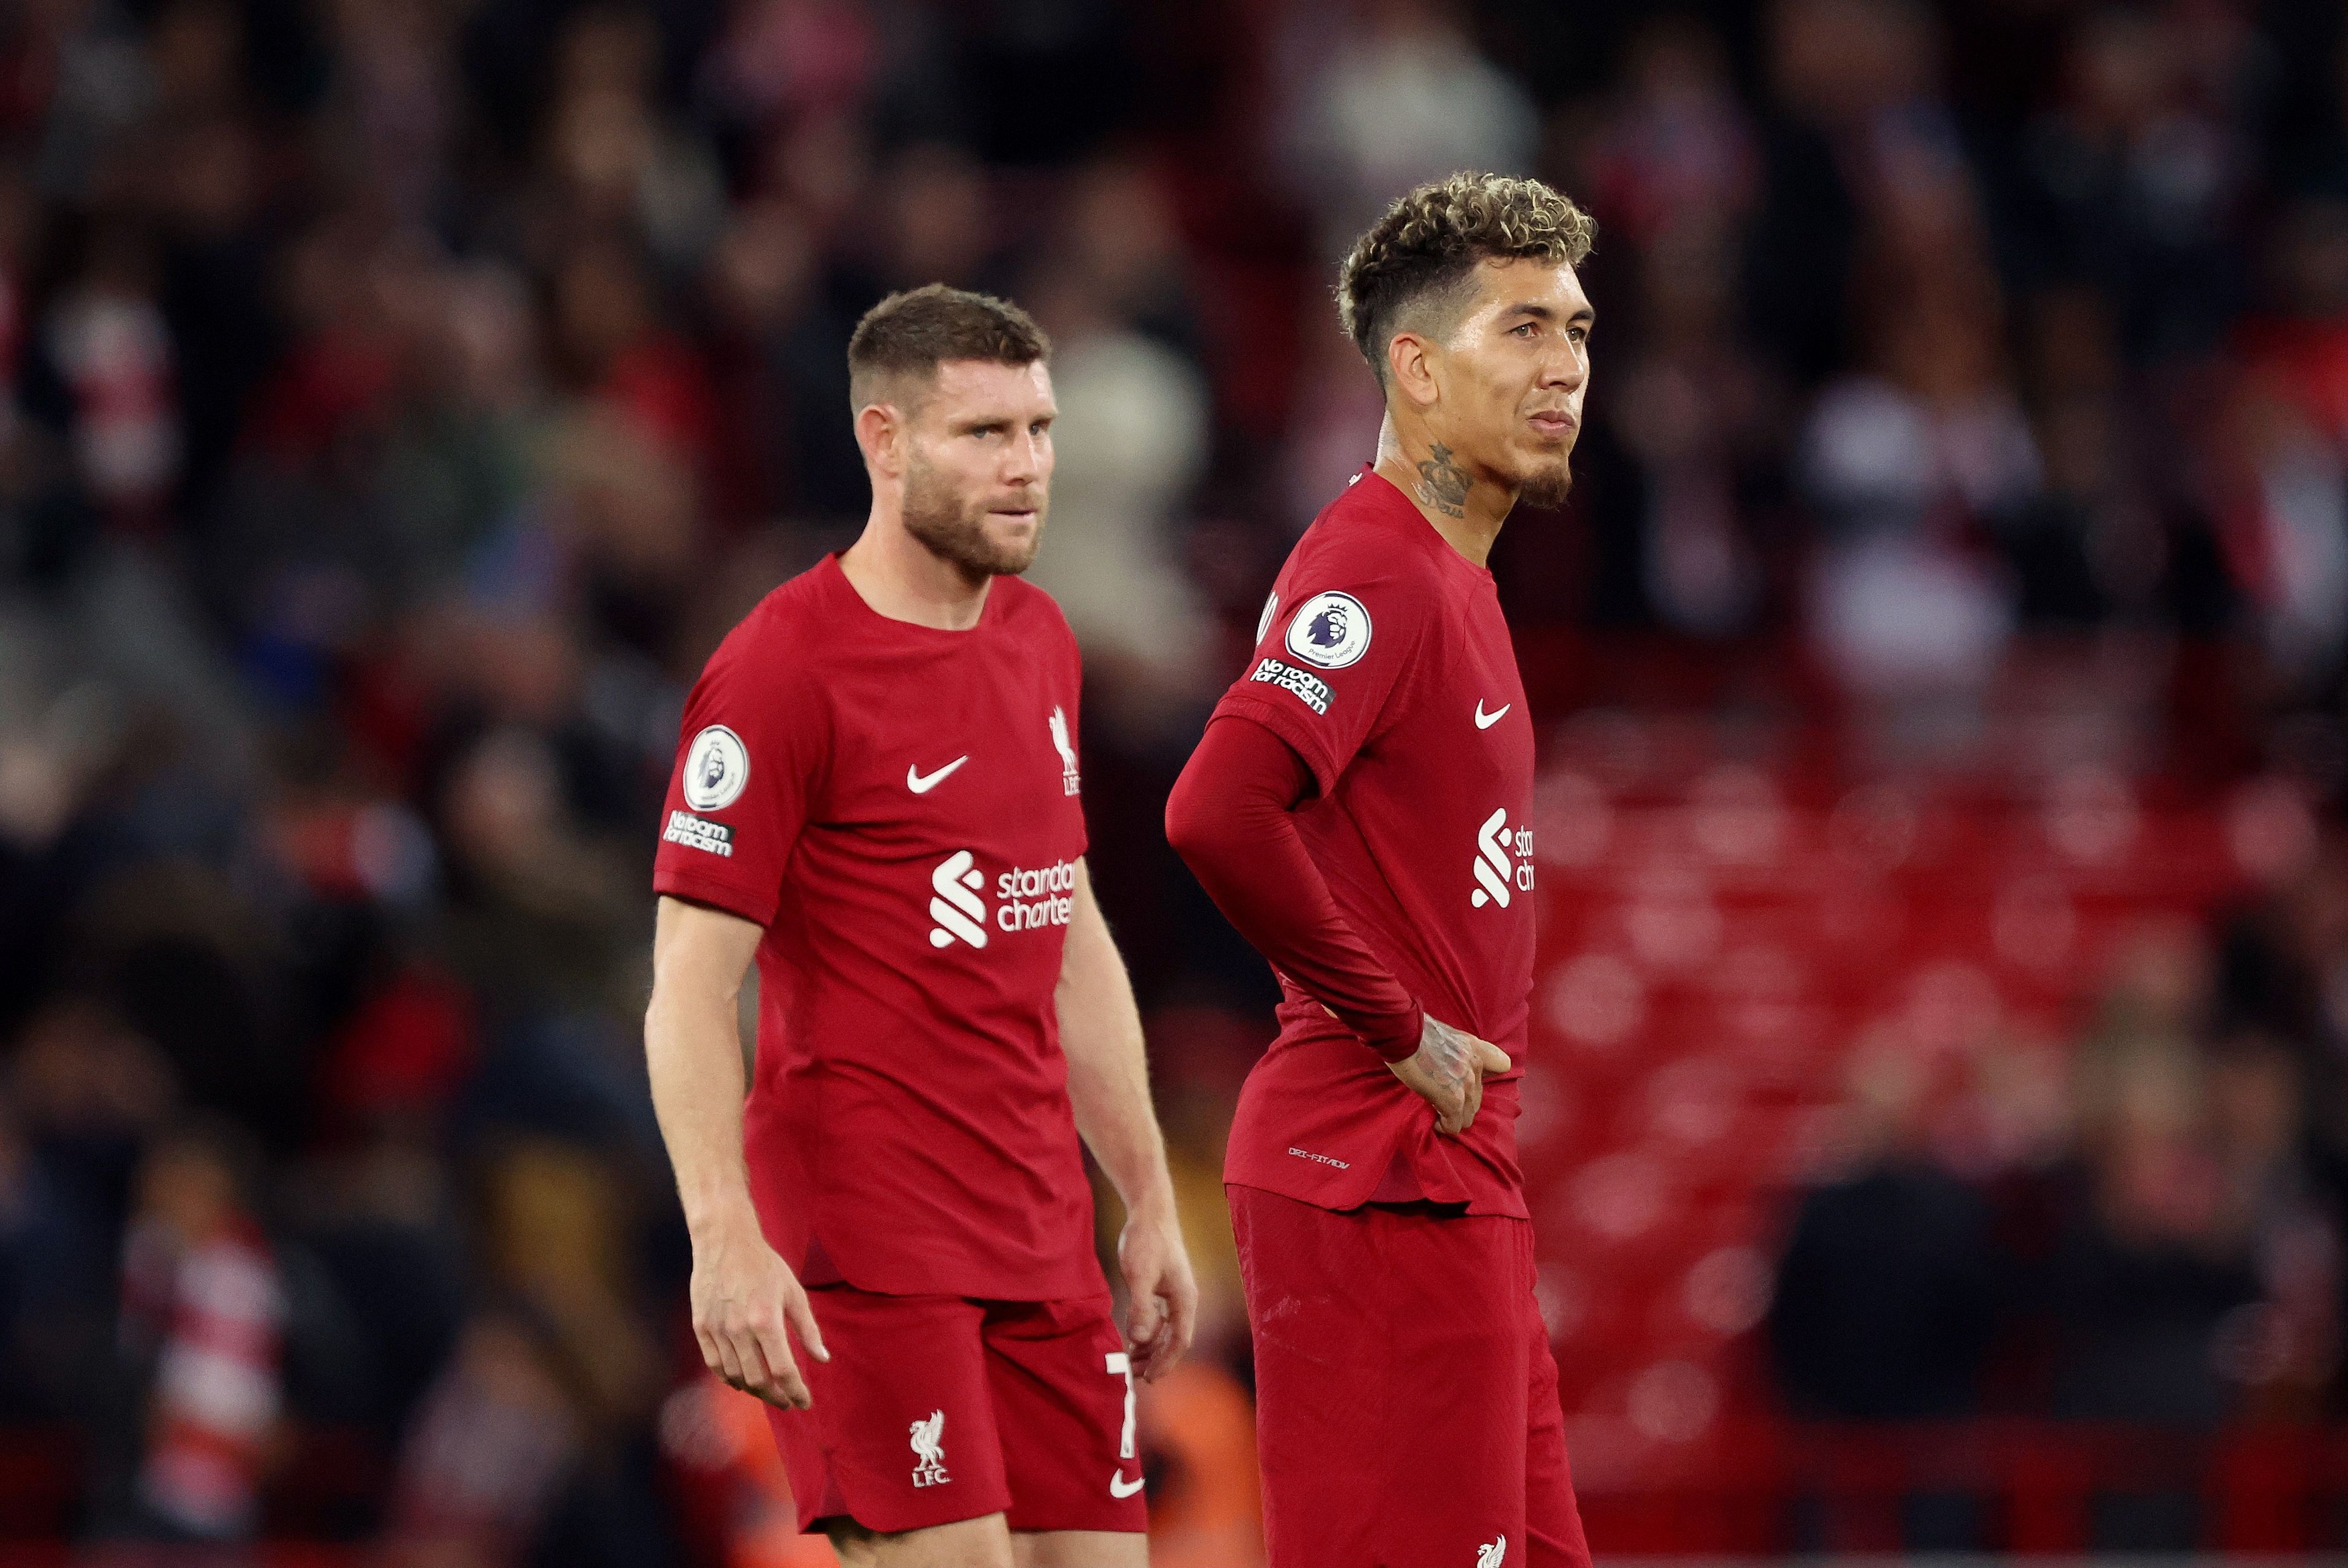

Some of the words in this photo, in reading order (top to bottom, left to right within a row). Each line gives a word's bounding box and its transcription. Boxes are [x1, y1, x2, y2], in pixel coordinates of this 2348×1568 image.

[1308, 648, 1334, 659] Premier
[1335, 641, 1356, 659] League
[1250, 670, 1277, 682] for
[1273, 674, 1327, 716] racism
[1257, 658, 1284, 672] No
[1281, 665, 1328, 699] room
[669, 809, 686, 829] No
[1105, 1352, 1136, 1459] 7
[912, 1468, 952, 1488] LFC
